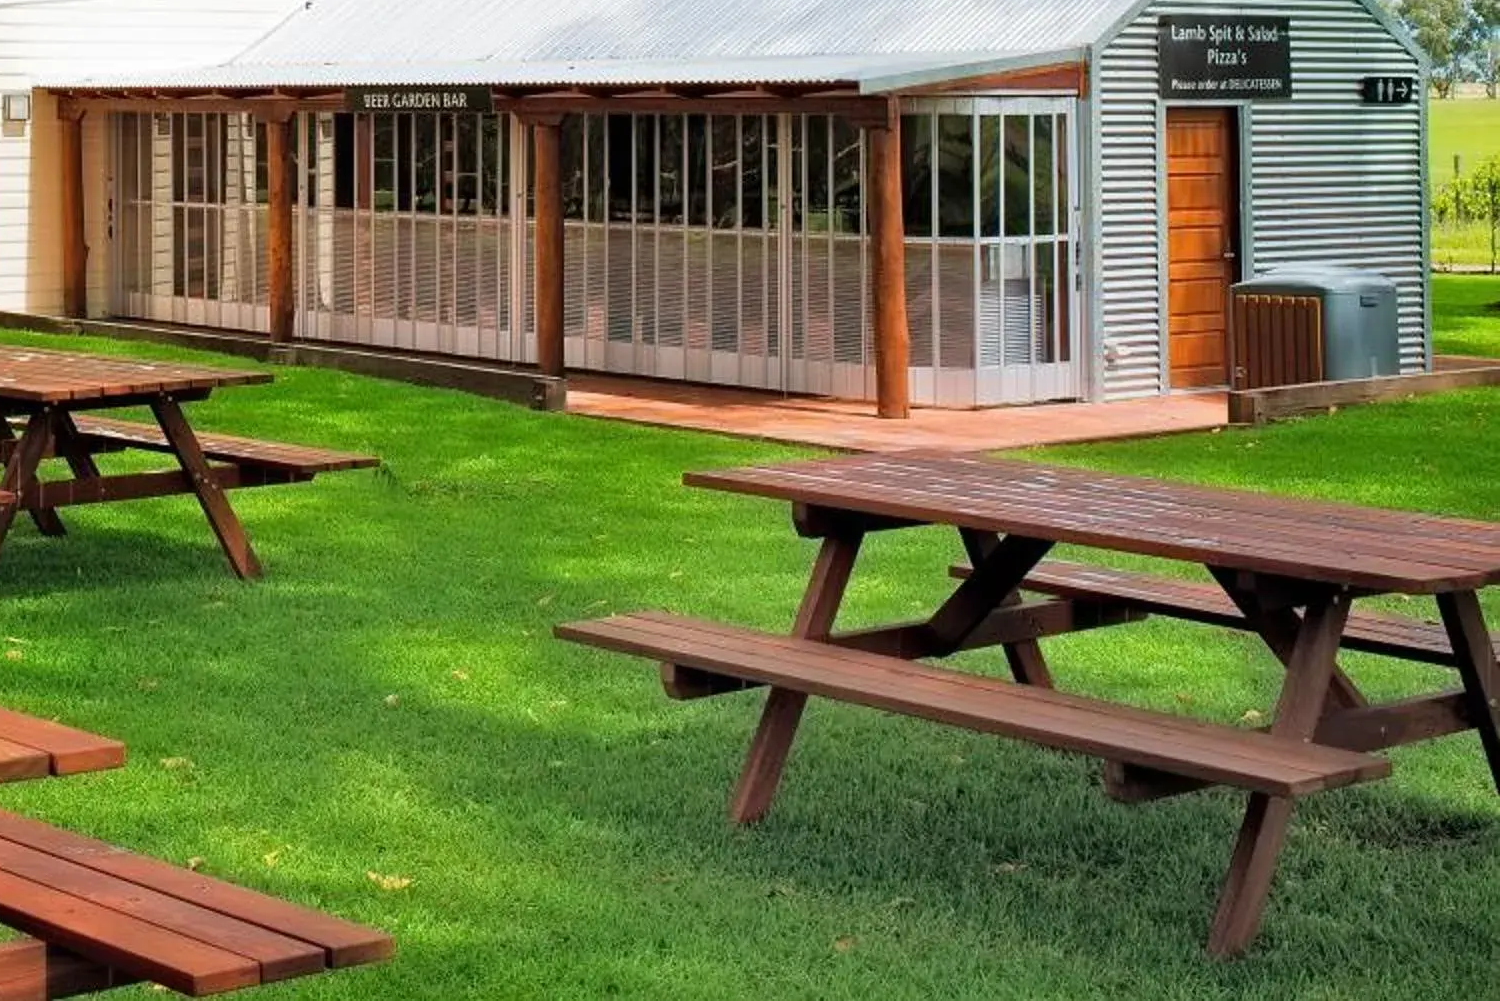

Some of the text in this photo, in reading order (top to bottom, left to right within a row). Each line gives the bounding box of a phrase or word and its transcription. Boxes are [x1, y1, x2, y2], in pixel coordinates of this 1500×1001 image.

[1171, 24, 1278, 45] Lamb Spit & Salad
[1207, 48, 1247, 66] Pizza's
[1171, 79, 1197, 90] Please
[1228, 79, 1281, 90] DELICATESSEN
[364, 93, 468, 108] BEER GARDEN BAR
